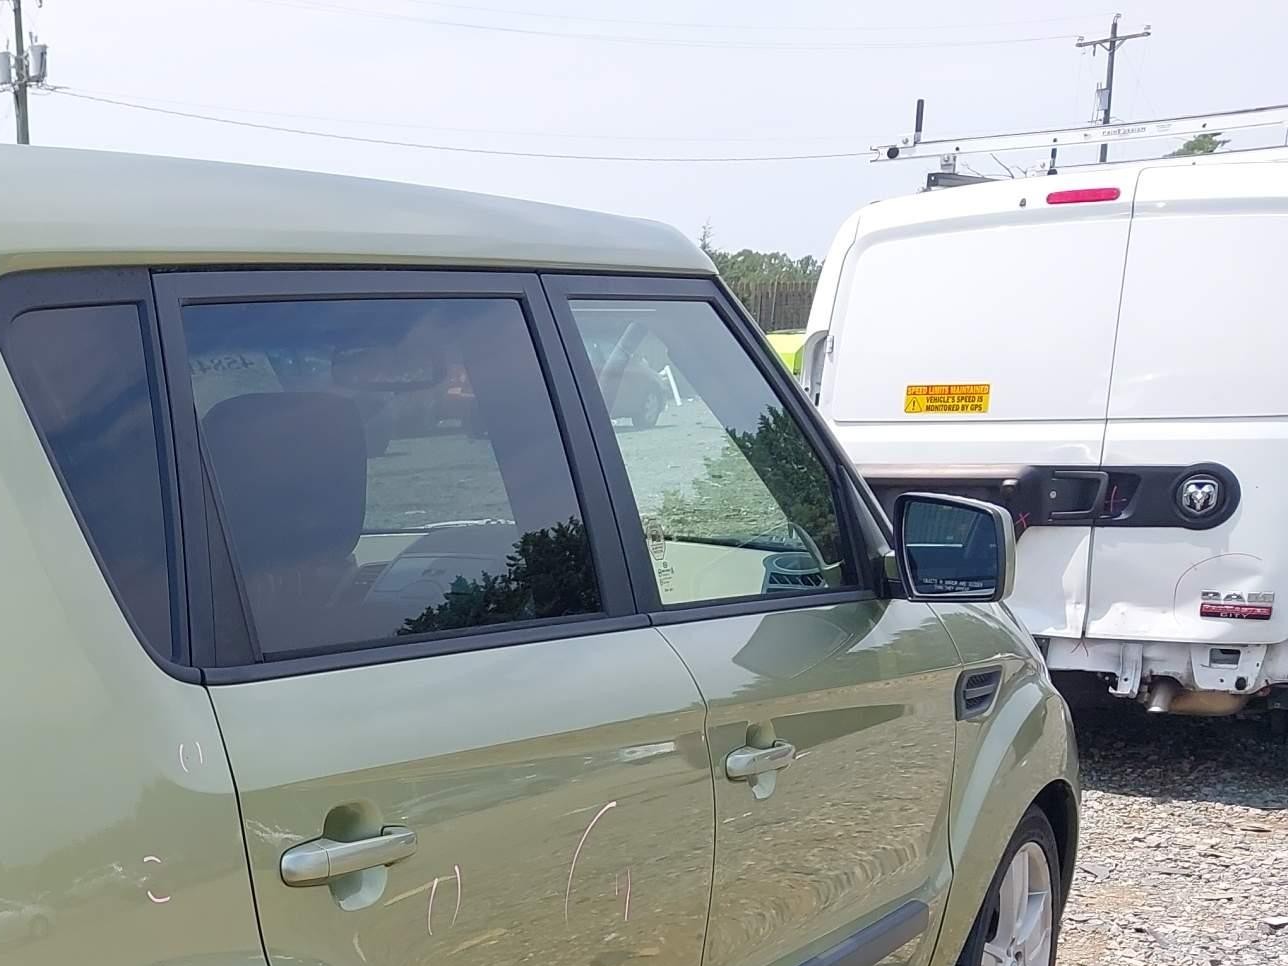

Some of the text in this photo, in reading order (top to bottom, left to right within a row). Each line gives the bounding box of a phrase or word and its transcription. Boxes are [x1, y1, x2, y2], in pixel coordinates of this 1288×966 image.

[926, 396, 955, 404] VEHICLE'S
[976, 395, 983, 403] IS
[926, 404, 960, 412] MONITORED
